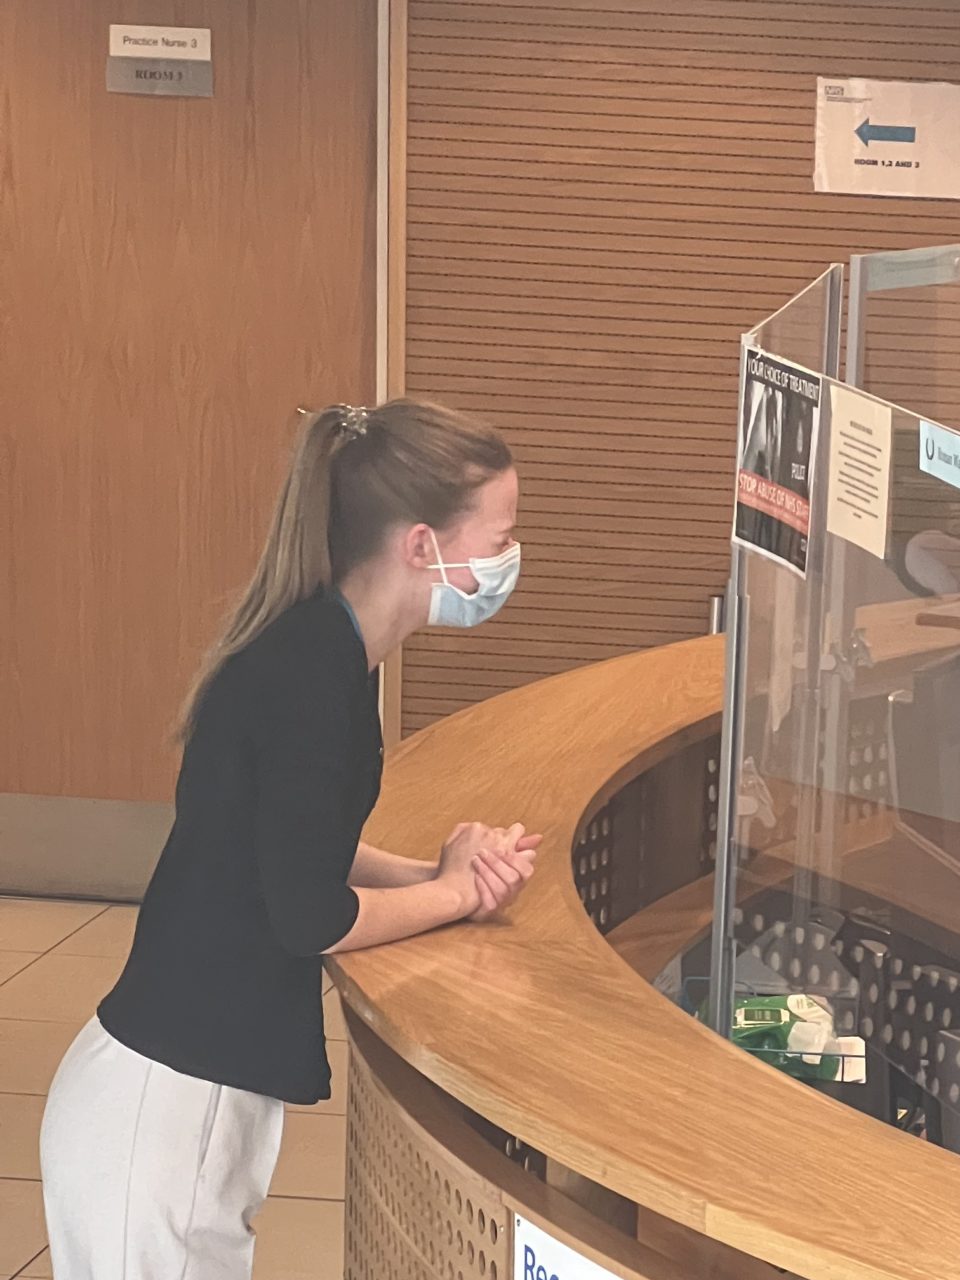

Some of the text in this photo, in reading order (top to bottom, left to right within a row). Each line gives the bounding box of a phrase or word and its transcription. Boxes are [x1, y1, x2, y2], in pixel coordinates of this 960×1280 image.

[123, 35, 198, 48] Practice Nurse 3
[135, 69, 173, 81] ROOM
[854, 158, 878, 166] ROOM
[895, 160, 912, 168] AND
[747, 357, 819, 401] YOUR CHOICE OF TREATMENT
[739, 472, 757, 494] STOP
[758, 480, 776, 504] ABUSE
[777, 489, 785, 506] OF
[785, 493, 797, 513] NHS
